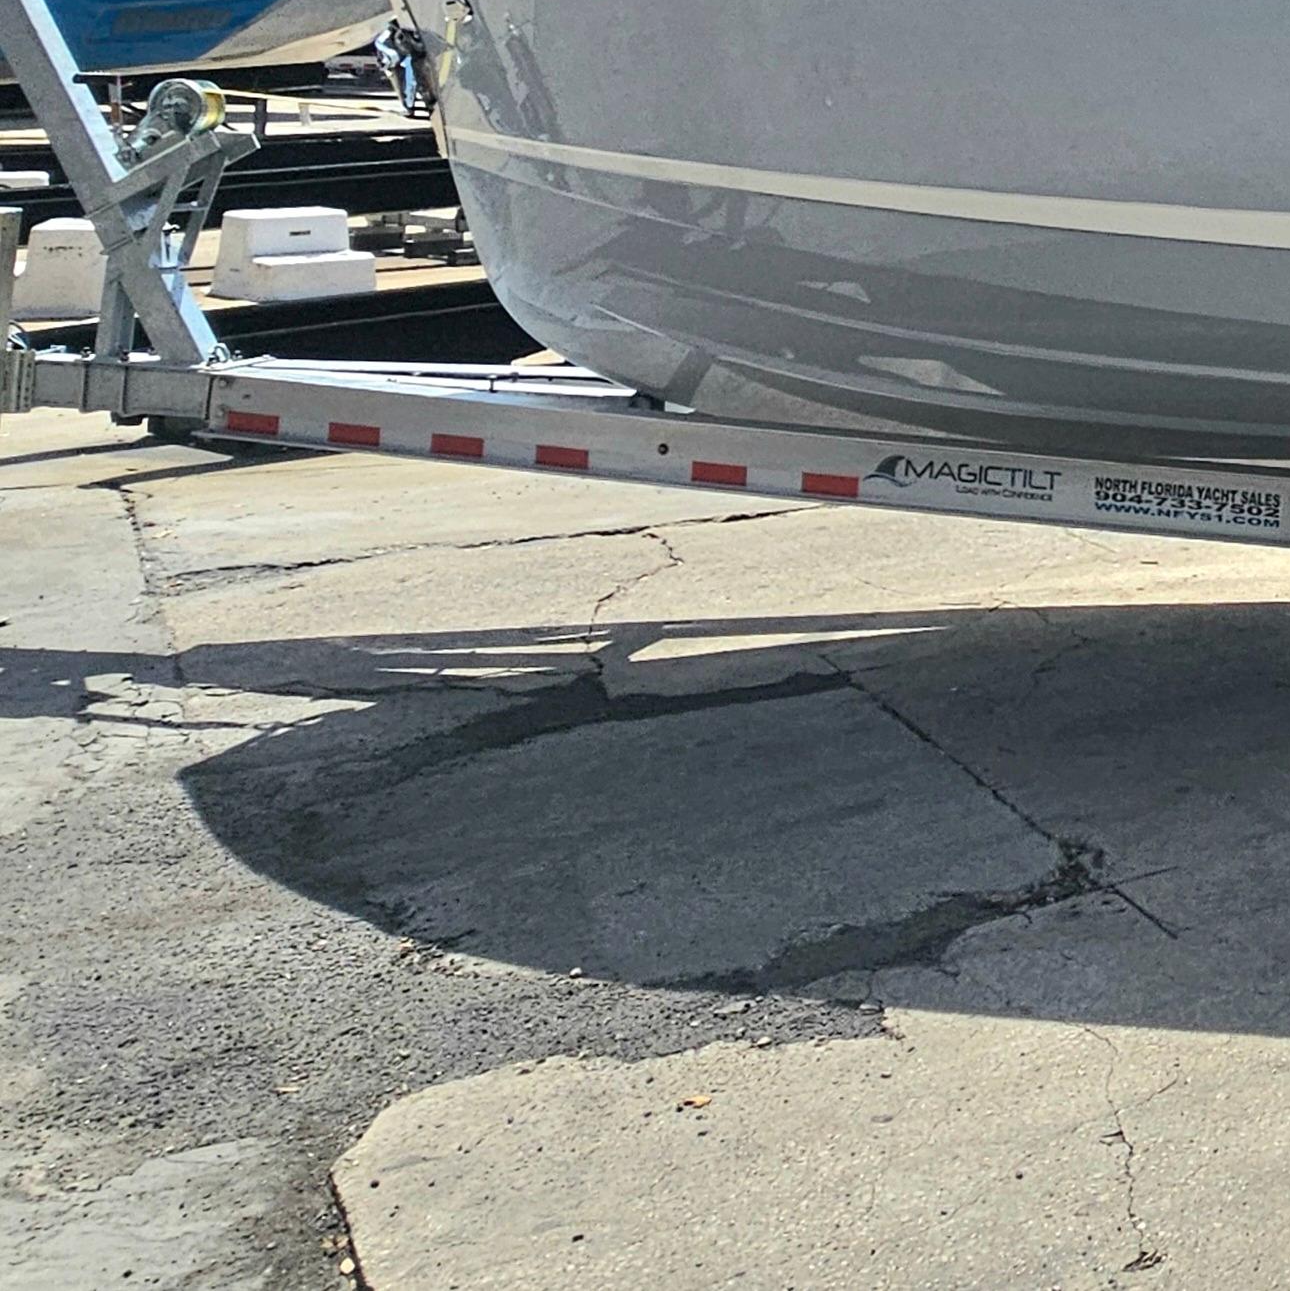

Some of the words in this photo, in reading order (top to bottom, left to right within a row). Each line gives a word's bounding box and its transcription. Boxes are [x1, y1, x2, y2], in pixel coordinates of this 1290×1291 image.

[903, 458, 1062, 490] MAGICTILT
[1094, 477, 1138, 494] NORTH
[1141, 482, 1194, 499] FLORIDA
[1196, 486, 1239, 503] YACHT
[1240, 491, 1281, 508] SALES
[1094, 490, 1281, 518] 904-733-7502
[1095, 502, 1281, 528] WWW.NFYS1.COM
